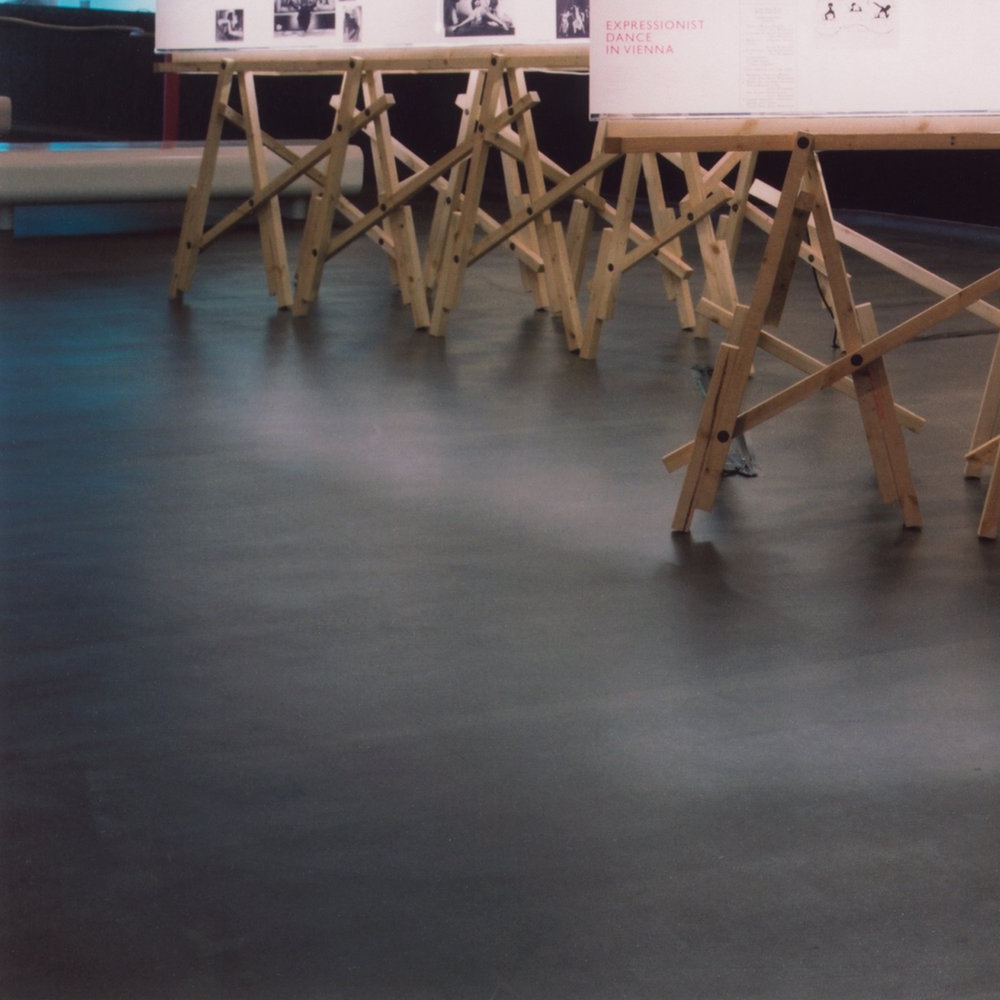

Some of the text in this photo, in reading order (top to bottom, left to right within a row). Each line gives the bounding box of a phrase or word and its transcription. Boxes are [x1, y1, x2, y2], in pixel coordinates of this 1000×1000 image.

[606, 20, 704, 30] EXPRESSIONIST
[606, 32, 652, 42] DANCE
[606, 44, 674, 55] IN VIENNA
